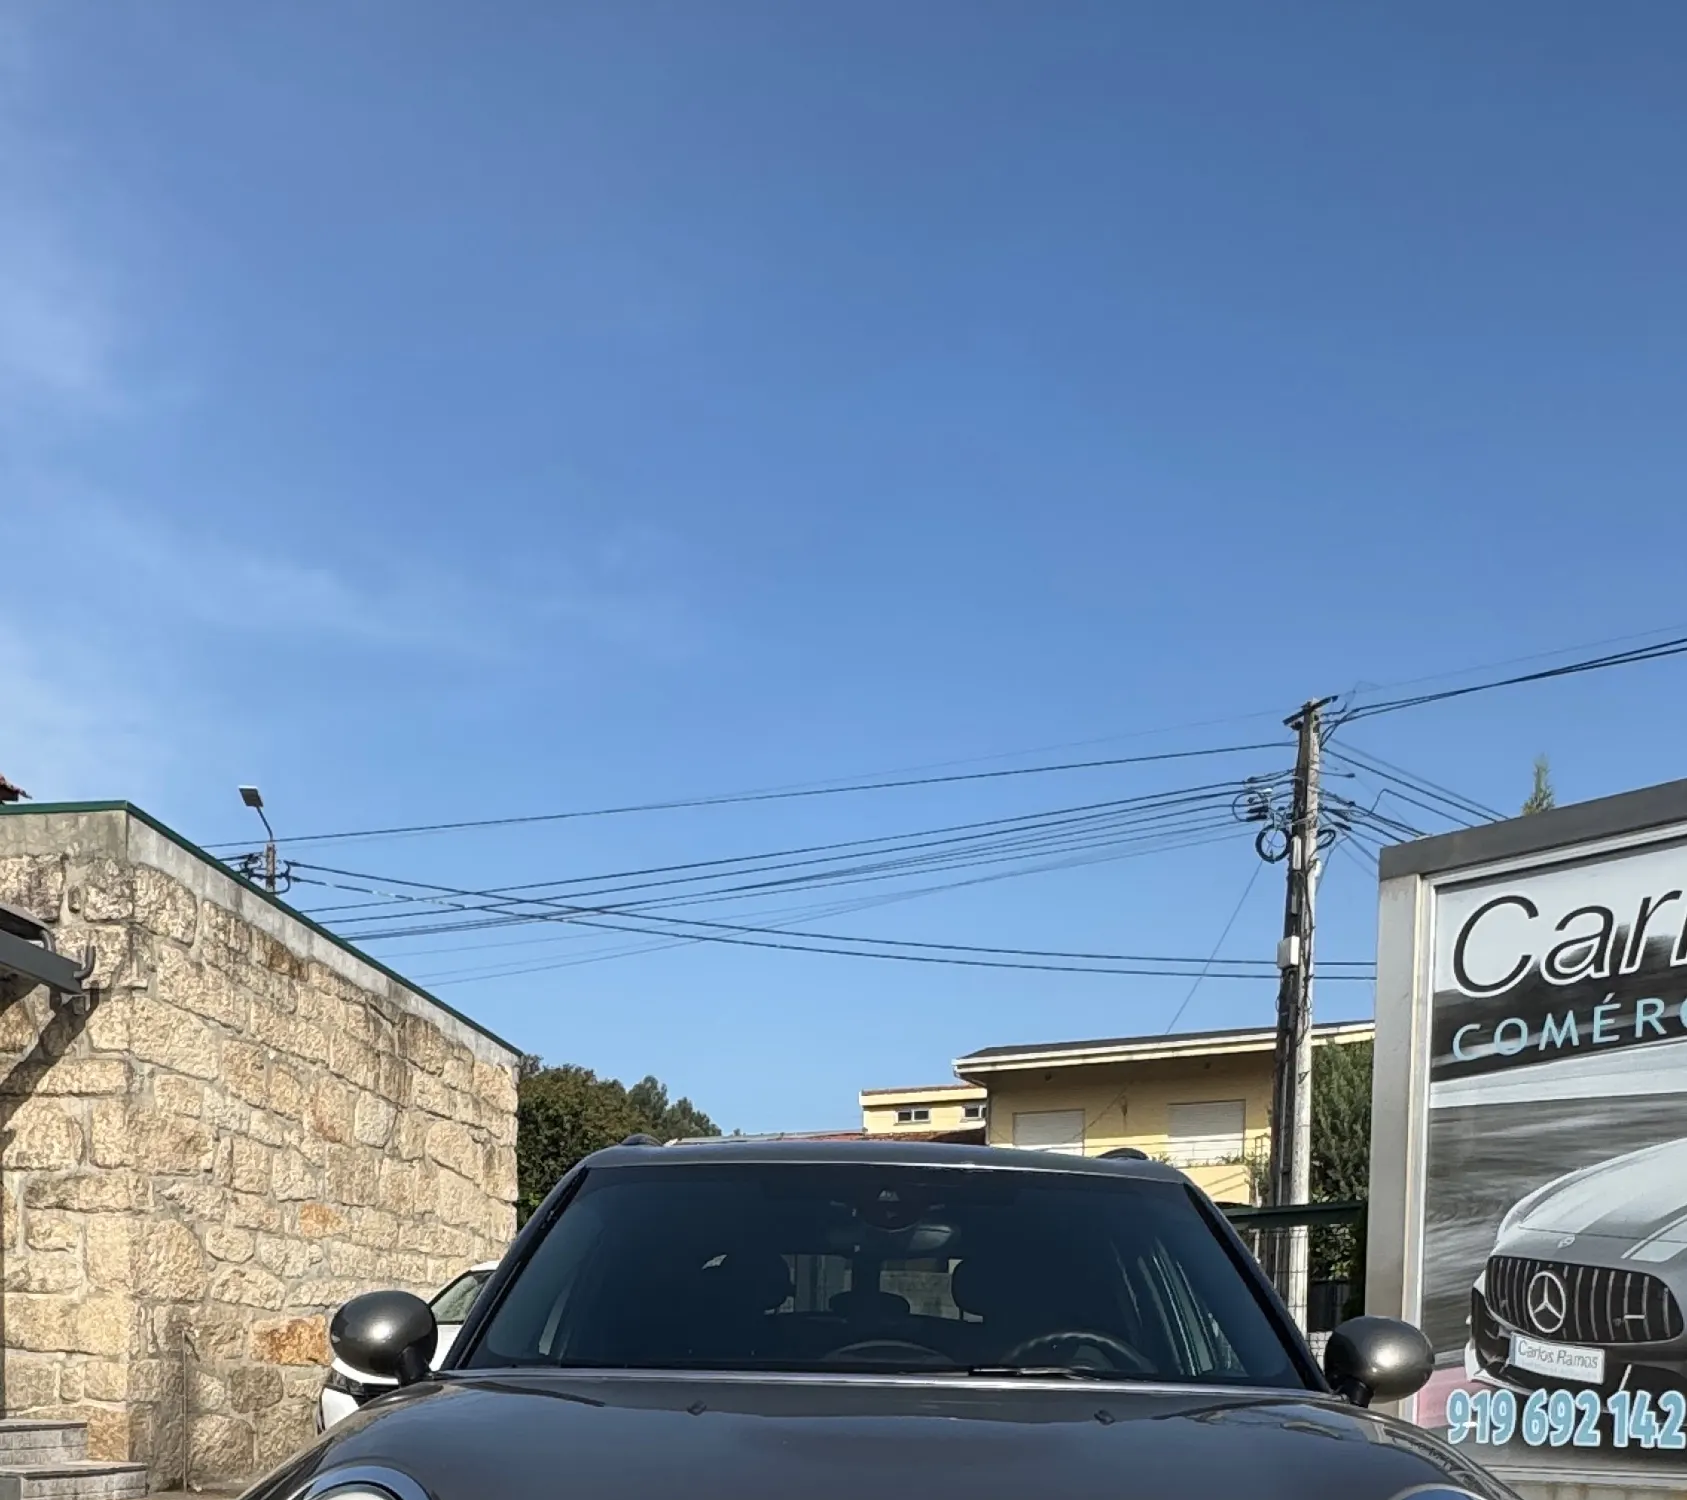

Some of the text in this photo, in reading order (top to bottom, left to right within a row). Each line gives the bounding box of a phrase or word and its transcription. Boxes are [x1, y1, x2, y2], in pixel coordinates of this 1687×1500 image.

[1452, 993, 1687, 1061] COMÉR
[1518, 1340, 1598, 1368] Carlos Ramos
[1446, 1388, 1686, 1448] 919 692 142
